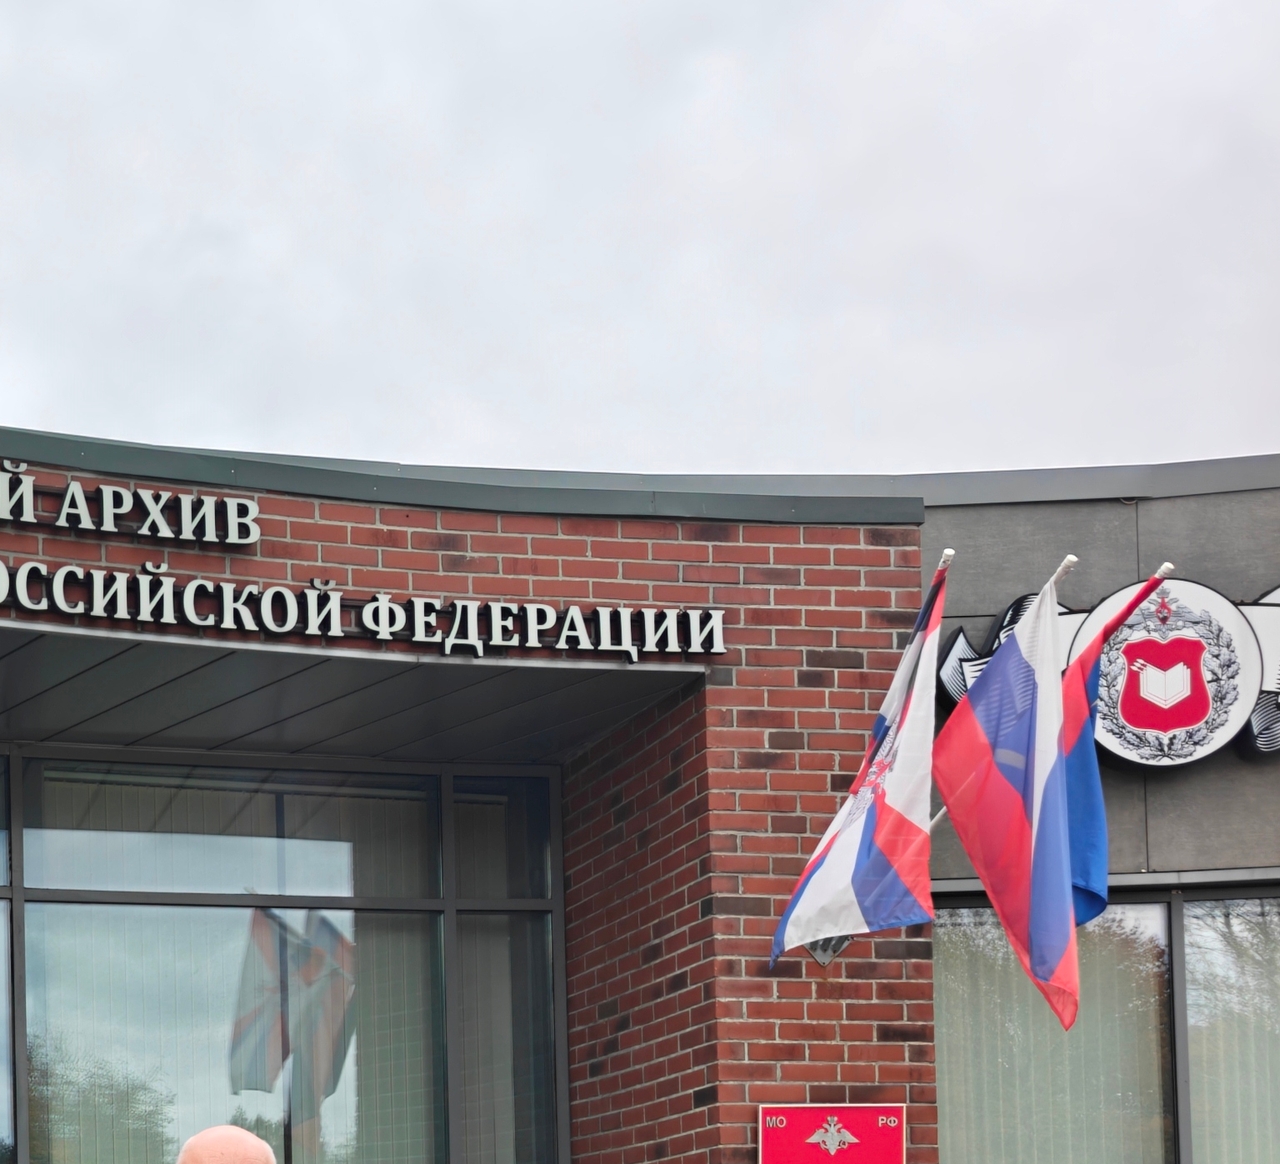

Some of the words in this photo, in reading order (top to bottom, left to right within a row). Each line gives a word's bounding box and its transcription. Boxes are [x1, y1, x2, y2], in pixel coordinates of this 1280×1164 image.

[55, 481, 262, 544] АРХИВ
[362, 593, 727, 662] ФЕДЕРАЦИИ
[766, 1116, 787, 1128] МО
[878, 1116, 899, 1128] РФ
